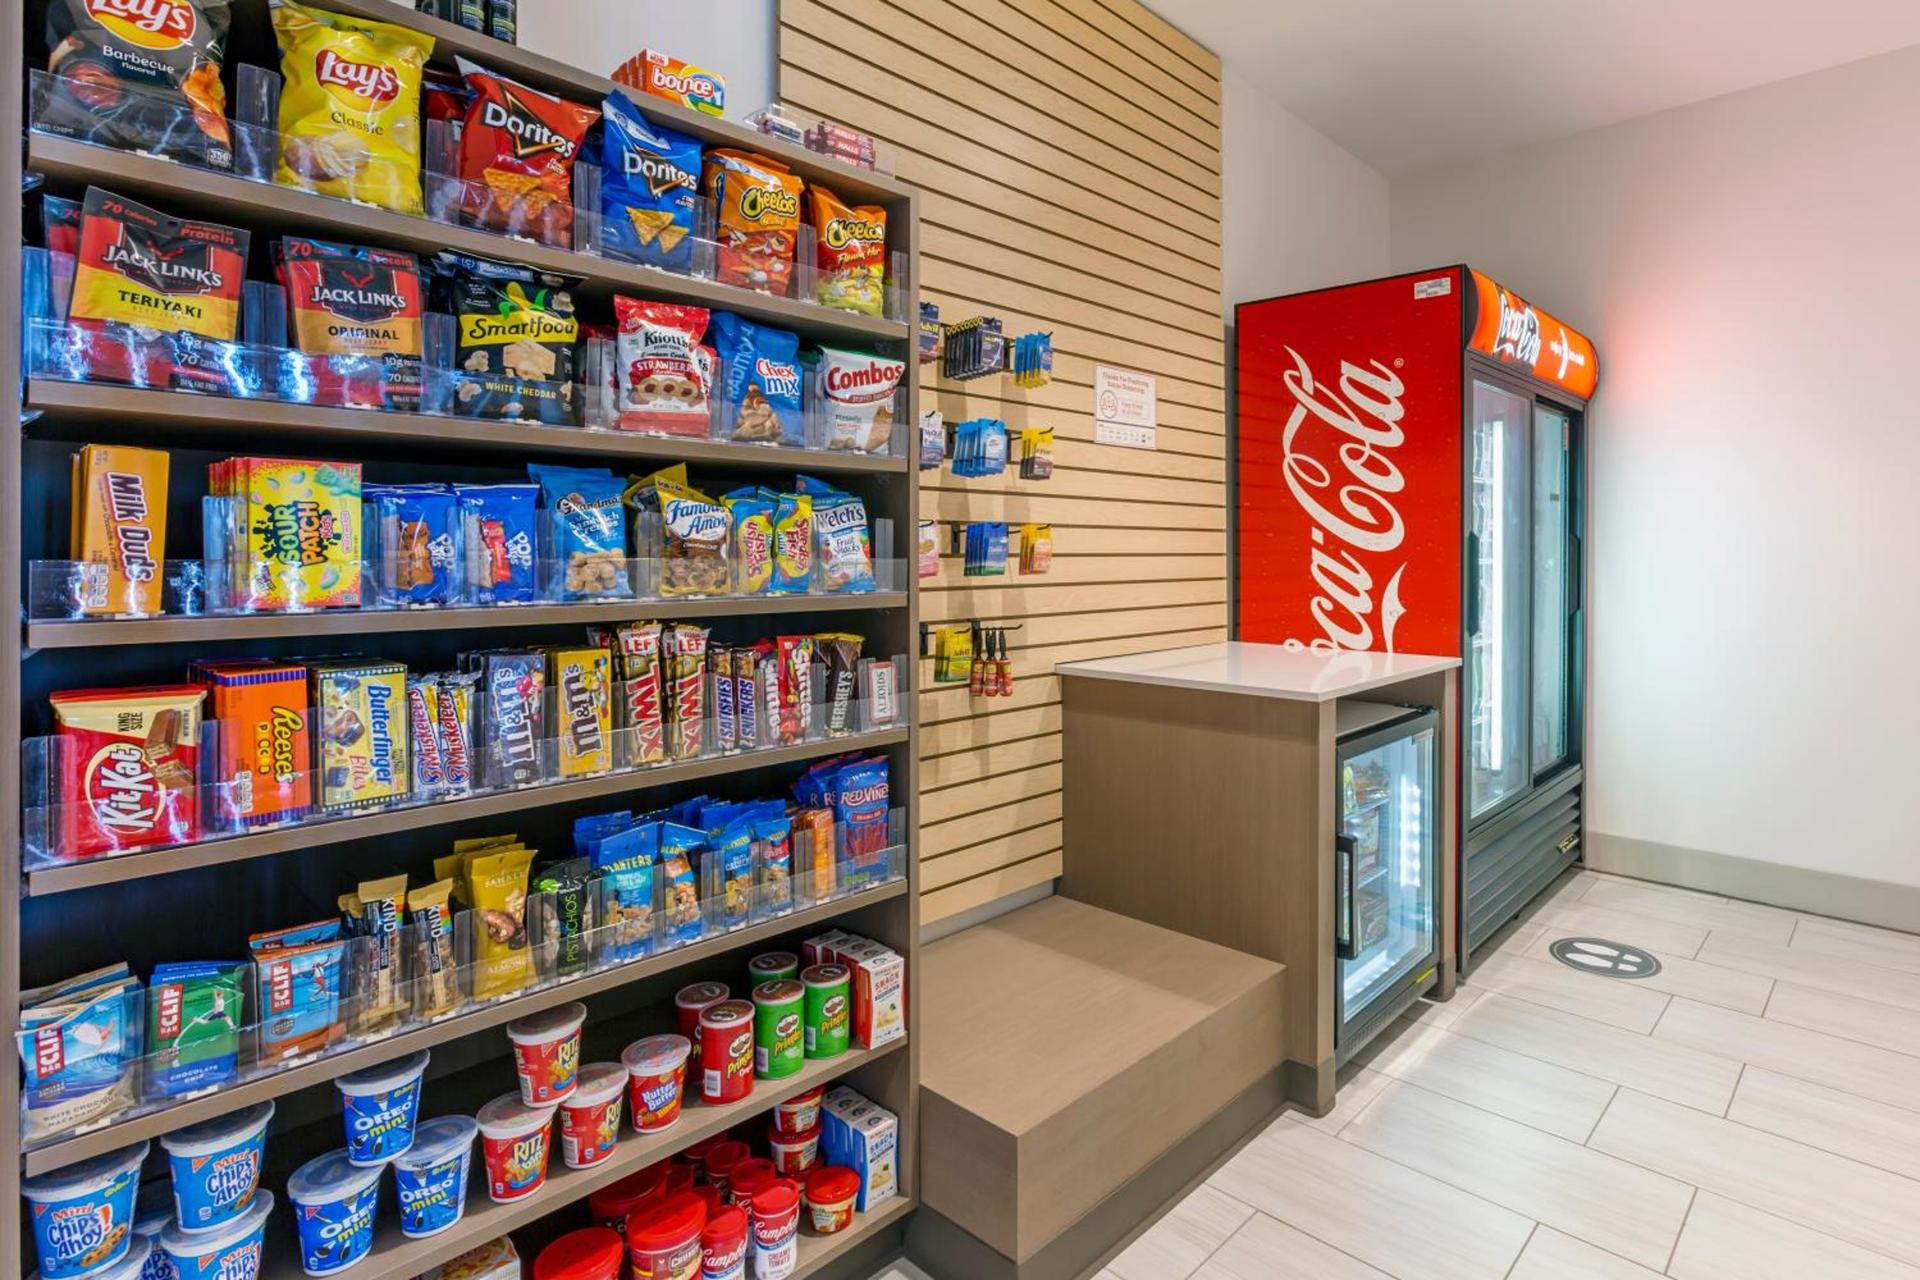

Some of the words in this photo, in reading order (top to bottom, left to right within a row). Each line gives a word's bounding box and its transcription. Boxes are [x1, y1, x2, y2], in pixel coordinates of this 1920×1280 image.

[103, 44, 175, 74] Barbecue
[653, 67, 712, 96] bounce
[331, 110, 384, 137] Classic
[485, 101, 576, 158] Doritos
[624, 145, 698, 192] Doritos
[102, 199, 124, 214] 70
[739, 186, 797, 221] Cheetos
[290, 241, 312, 257] 70
[103, 244, 158, 275] JACK
[160, 260, 222, 289] LINK'S
[118, 289, 203, 320] TERIYAKI
[311, 286, 355, 304] JACK
[357, 288, 407, 309] LINK'S
[328, 325, 400, 341] ORIGINAL
[388, 373, 402, 383] 70
[637, 360, 696, 373] STRAWBERR
[756, 357, 796, 379] Chex
[827, 361, 903, 392] Combos
[485, 381, 515, 394] WHITE
[516, 383, 557, 400] CHEDDAR
[107, 471, 149, 524] Milk
[665, 498, 727, 526] Famous
[1282, 344, 1407, 653] ca-Cola
[272, 503, 300, 565] SOUR
[299, 500, 325, 567] PATCH
[681, 515, 728, 538] Amos
[814, 509, 866, 530] Welch's
[116, 524, 157, 582] Duds
[744, 520, 762, 580] Swedish
[785, 530, 799, 562] Fish
[794, 517, 810, 572] Swedish
[622, 637, 661, 653] LEF
[678, 637, 704, 653] LEF
[716, 676, 734, 738] SATISFIES
[831, 670, 854, 728] HERSHEY'S
[877, 670, 887, 714] ALTOIDS
[117, 711, 131, 732] KING
[131, 711, 143, 731] SIZE
[625, 662, 665, 759] TWIX
[738, 678, 755, 738] SNICKERS
[367, 684, 393, 786] Butterfinger
[409, 689, 442, 768] Musketeers
[271, 706, 304, 785] Reese's
[841, 790, 866, 806] RED
[381, 897, 396, 934] KIND
[427, 904, 444, 939] KIND
[565, 893, 580, 962] PISTACHIOS
[273, 962, 290, 999] CLIF
[874, 972, 900, 991] SNACK
[160, 988, 181, 1026] CLIF
[160, 1024, 178, 1034] BAR
[39, 1026, 62, 1065] CLIF
[40, 1062, 62, 1075] BAR
[169, 1064, 219, 1081] CHOCOLATE
[184, 1074, 205, 1084] CHIP
[642, 1081, 676, 1103] Nutter
[648, 1087, 681, 1112] Butter
[354, 1101, 413, 1132] OREO
[368, 1113, 407, 1138] mini
[214, 1149, 252, 1169] Mini
[513, 1132, 545, 1163] RITZ
[206, 1160, 252, 1197] Chips
[400, 1178, 453, 1203] OREO
[51, 1202, 94, 1222] Mini
[411, 1190, 448, 1212] mini
[48, 1210, 101, 1248] Chips
[319, 1200, 377, 1240] OREO
[336, 1214, 372, 1243] mini
